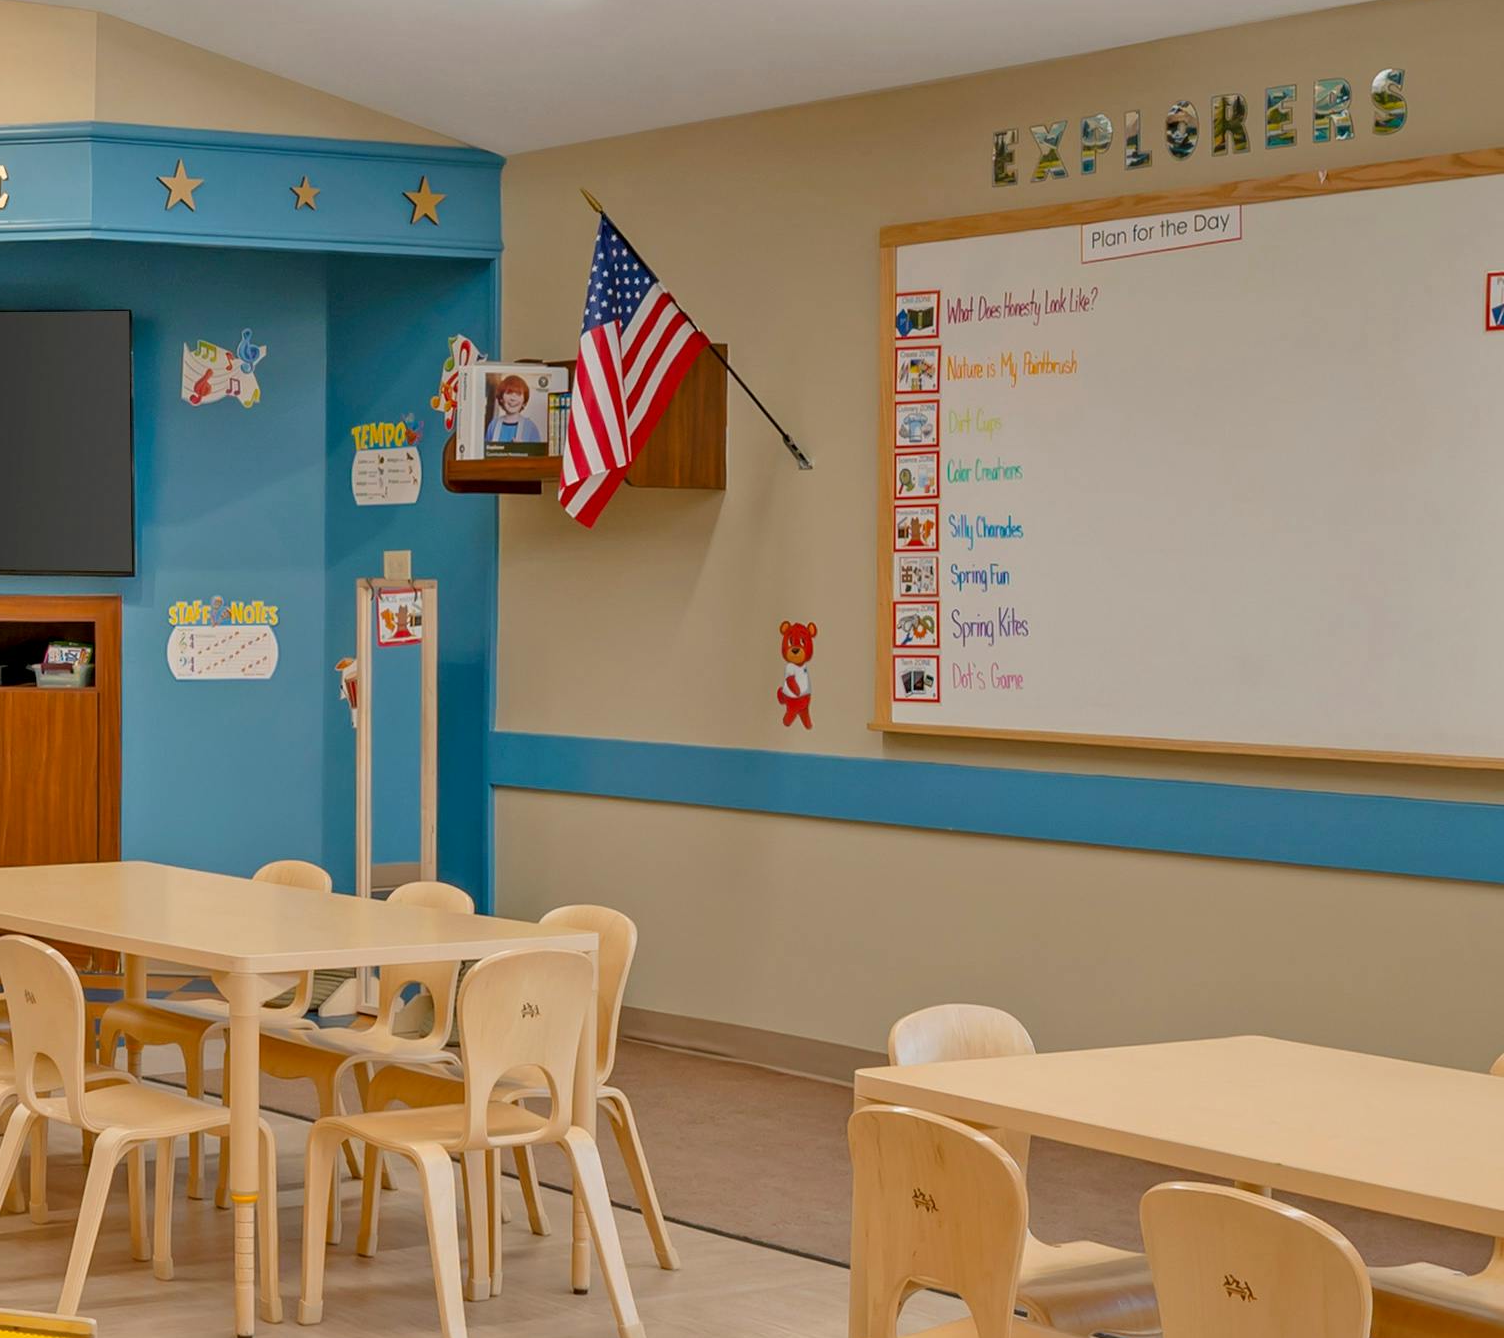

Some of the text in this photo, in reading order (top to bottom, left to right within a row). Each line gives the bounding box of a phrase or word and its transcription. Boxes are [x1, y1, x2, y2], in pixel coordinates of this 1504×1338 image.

[992, 68, 1408, 187] EXPLORERS
[1091, 214, 1230, 249] Plan for the Day
[947, 287, 1098, 326] What Does Honesty Look Like?
[947, 356, 983, 381] Nature
[987, 359, 996, 378] is
[1001, 351, 1017, 387] My
[352, 421, 407, 451] TEMPO
[948, 514, 1024, 551] Silly Charades
[951, 563, 1010, 592] Spring Fun
[169, 601, 278, 626] STAFF NOTES
[952, 607, 1029, 647] Spring Kites
[952, 661, 1024, 690] Dot's Game
